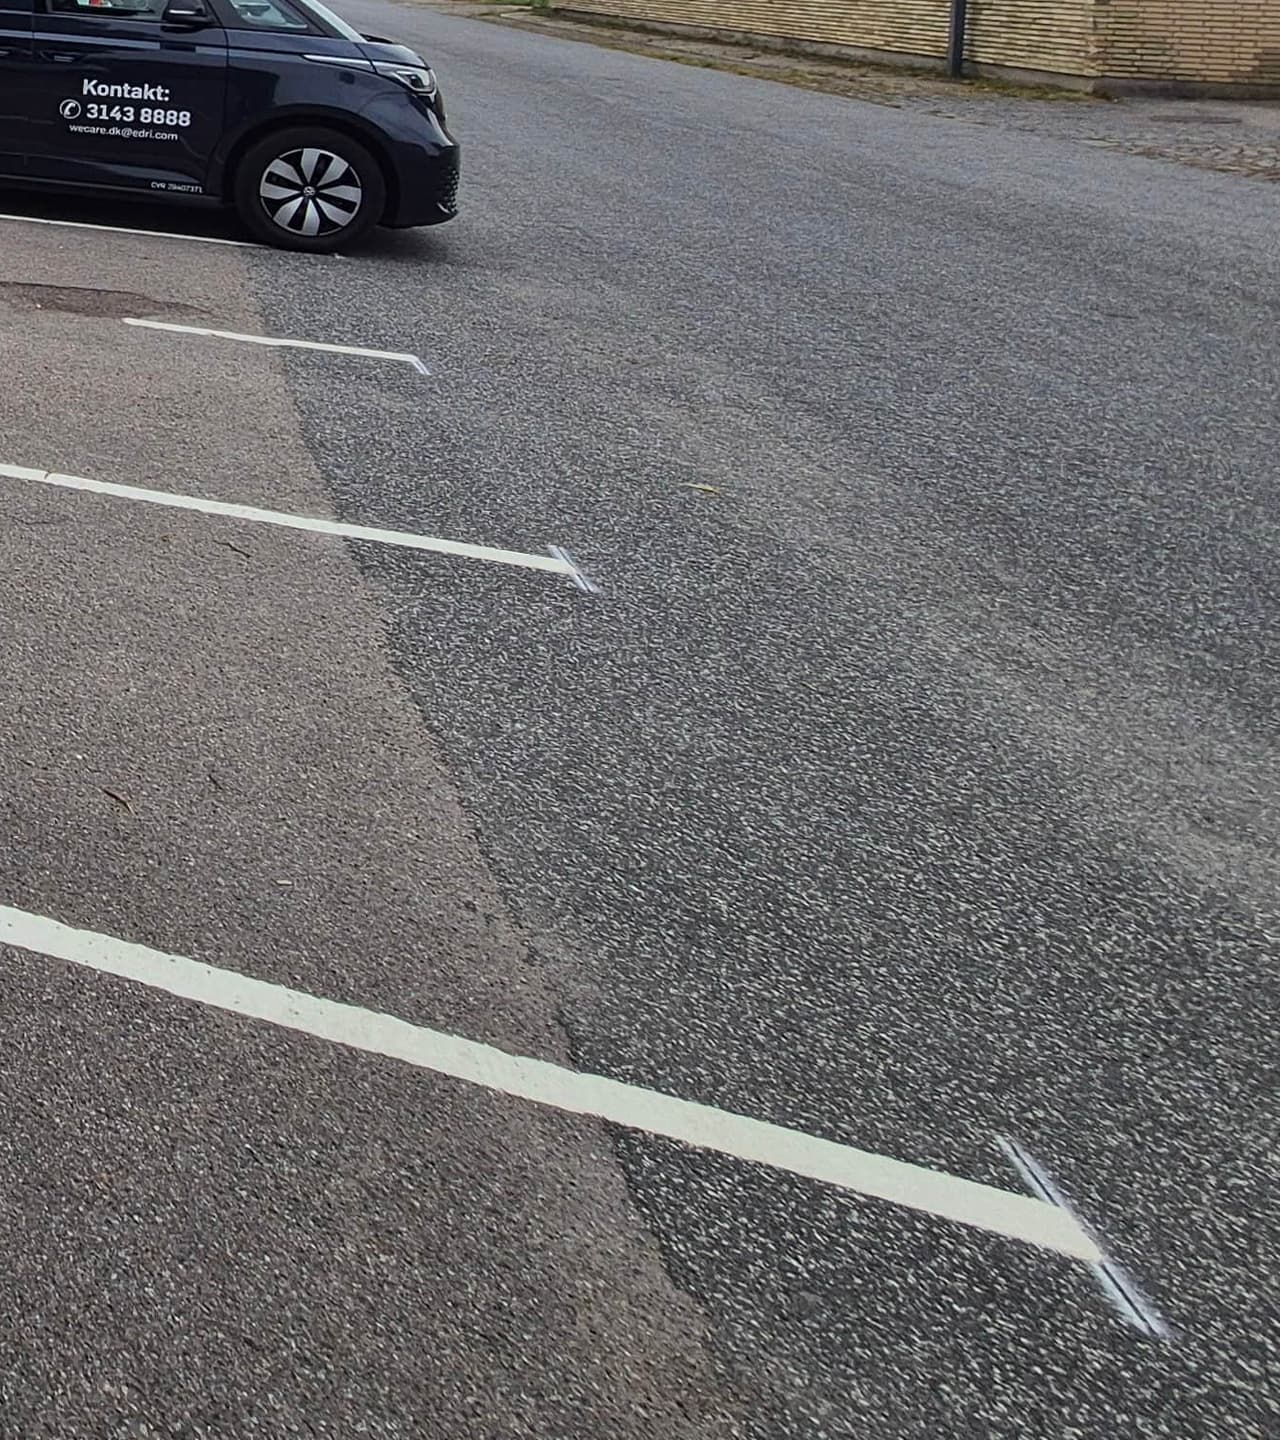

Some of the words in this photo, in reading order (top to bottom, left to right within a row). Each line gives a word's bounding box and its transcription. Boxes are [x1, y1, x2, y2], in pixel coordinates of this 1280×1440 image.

[82, 78, 170, 102] Kontakt:
[86, 103, 135, 122] 3143
[140, 107, 191, 127] 8888
[69, 124, 179, 141] wecare.dk@edri.com
